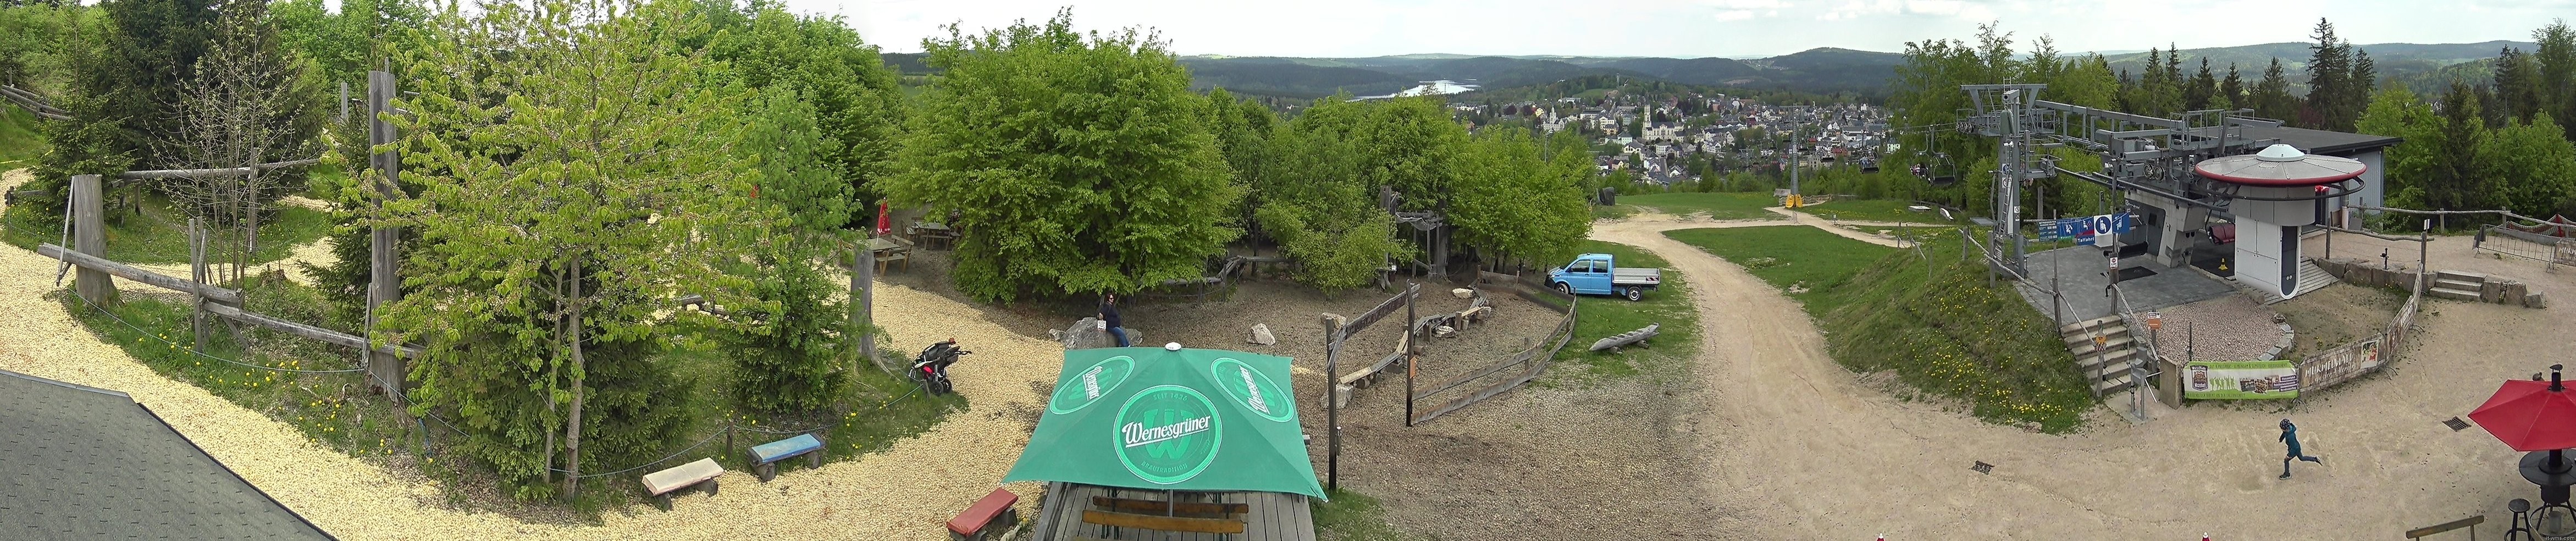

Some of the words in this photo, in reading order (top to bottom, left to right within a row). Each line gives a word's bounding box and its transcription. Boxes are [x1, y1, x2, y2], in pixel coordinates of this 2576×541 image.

[2305, 352, 2354, 378] MURMELWALD
[1170, 393, 1187, 401] 1436
[1121, 415, 1211, 444] Wernesgrüner
[1141, 461, 1187, 473] BRAUTRADITION
